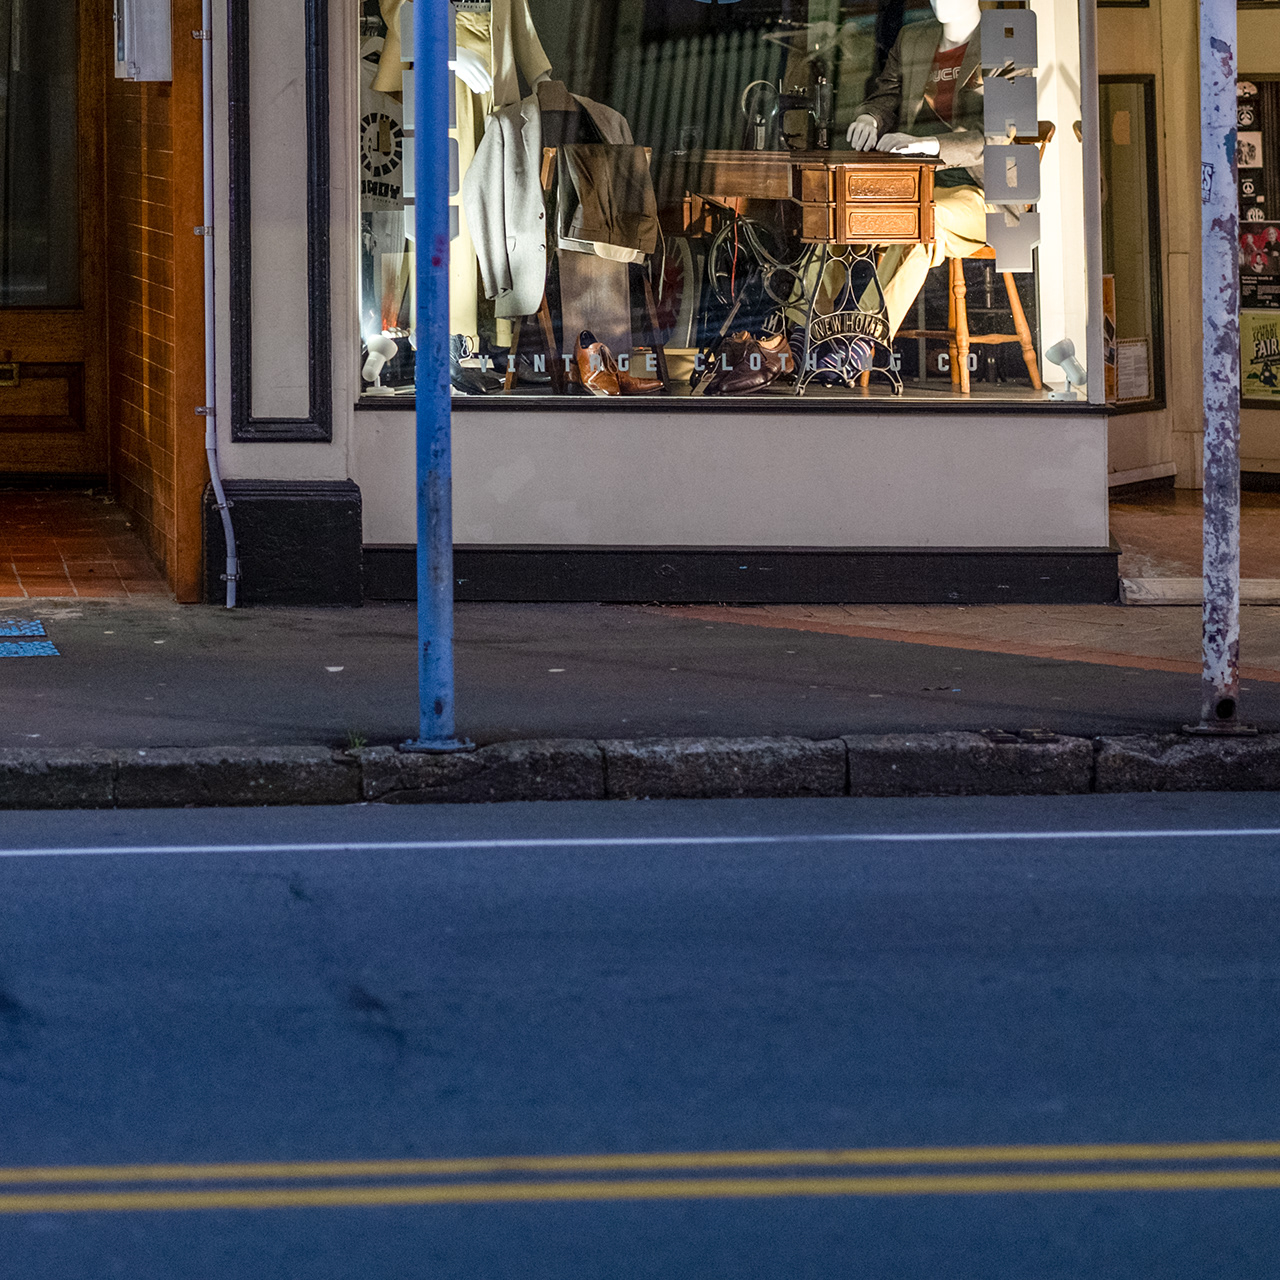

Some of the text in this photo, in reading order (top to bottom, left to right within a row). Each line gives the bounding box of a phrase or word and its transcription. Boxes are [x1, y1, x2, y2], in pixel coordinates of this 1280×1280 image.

[814, 316, 841, 337] NEW
[1253, 328, 1278, 342] SCHOOL
[1253, 339, 1279, 357] FAIR
[478, 353, 658, 373] VINTAGE
[937, 352, 978, 372] CO
